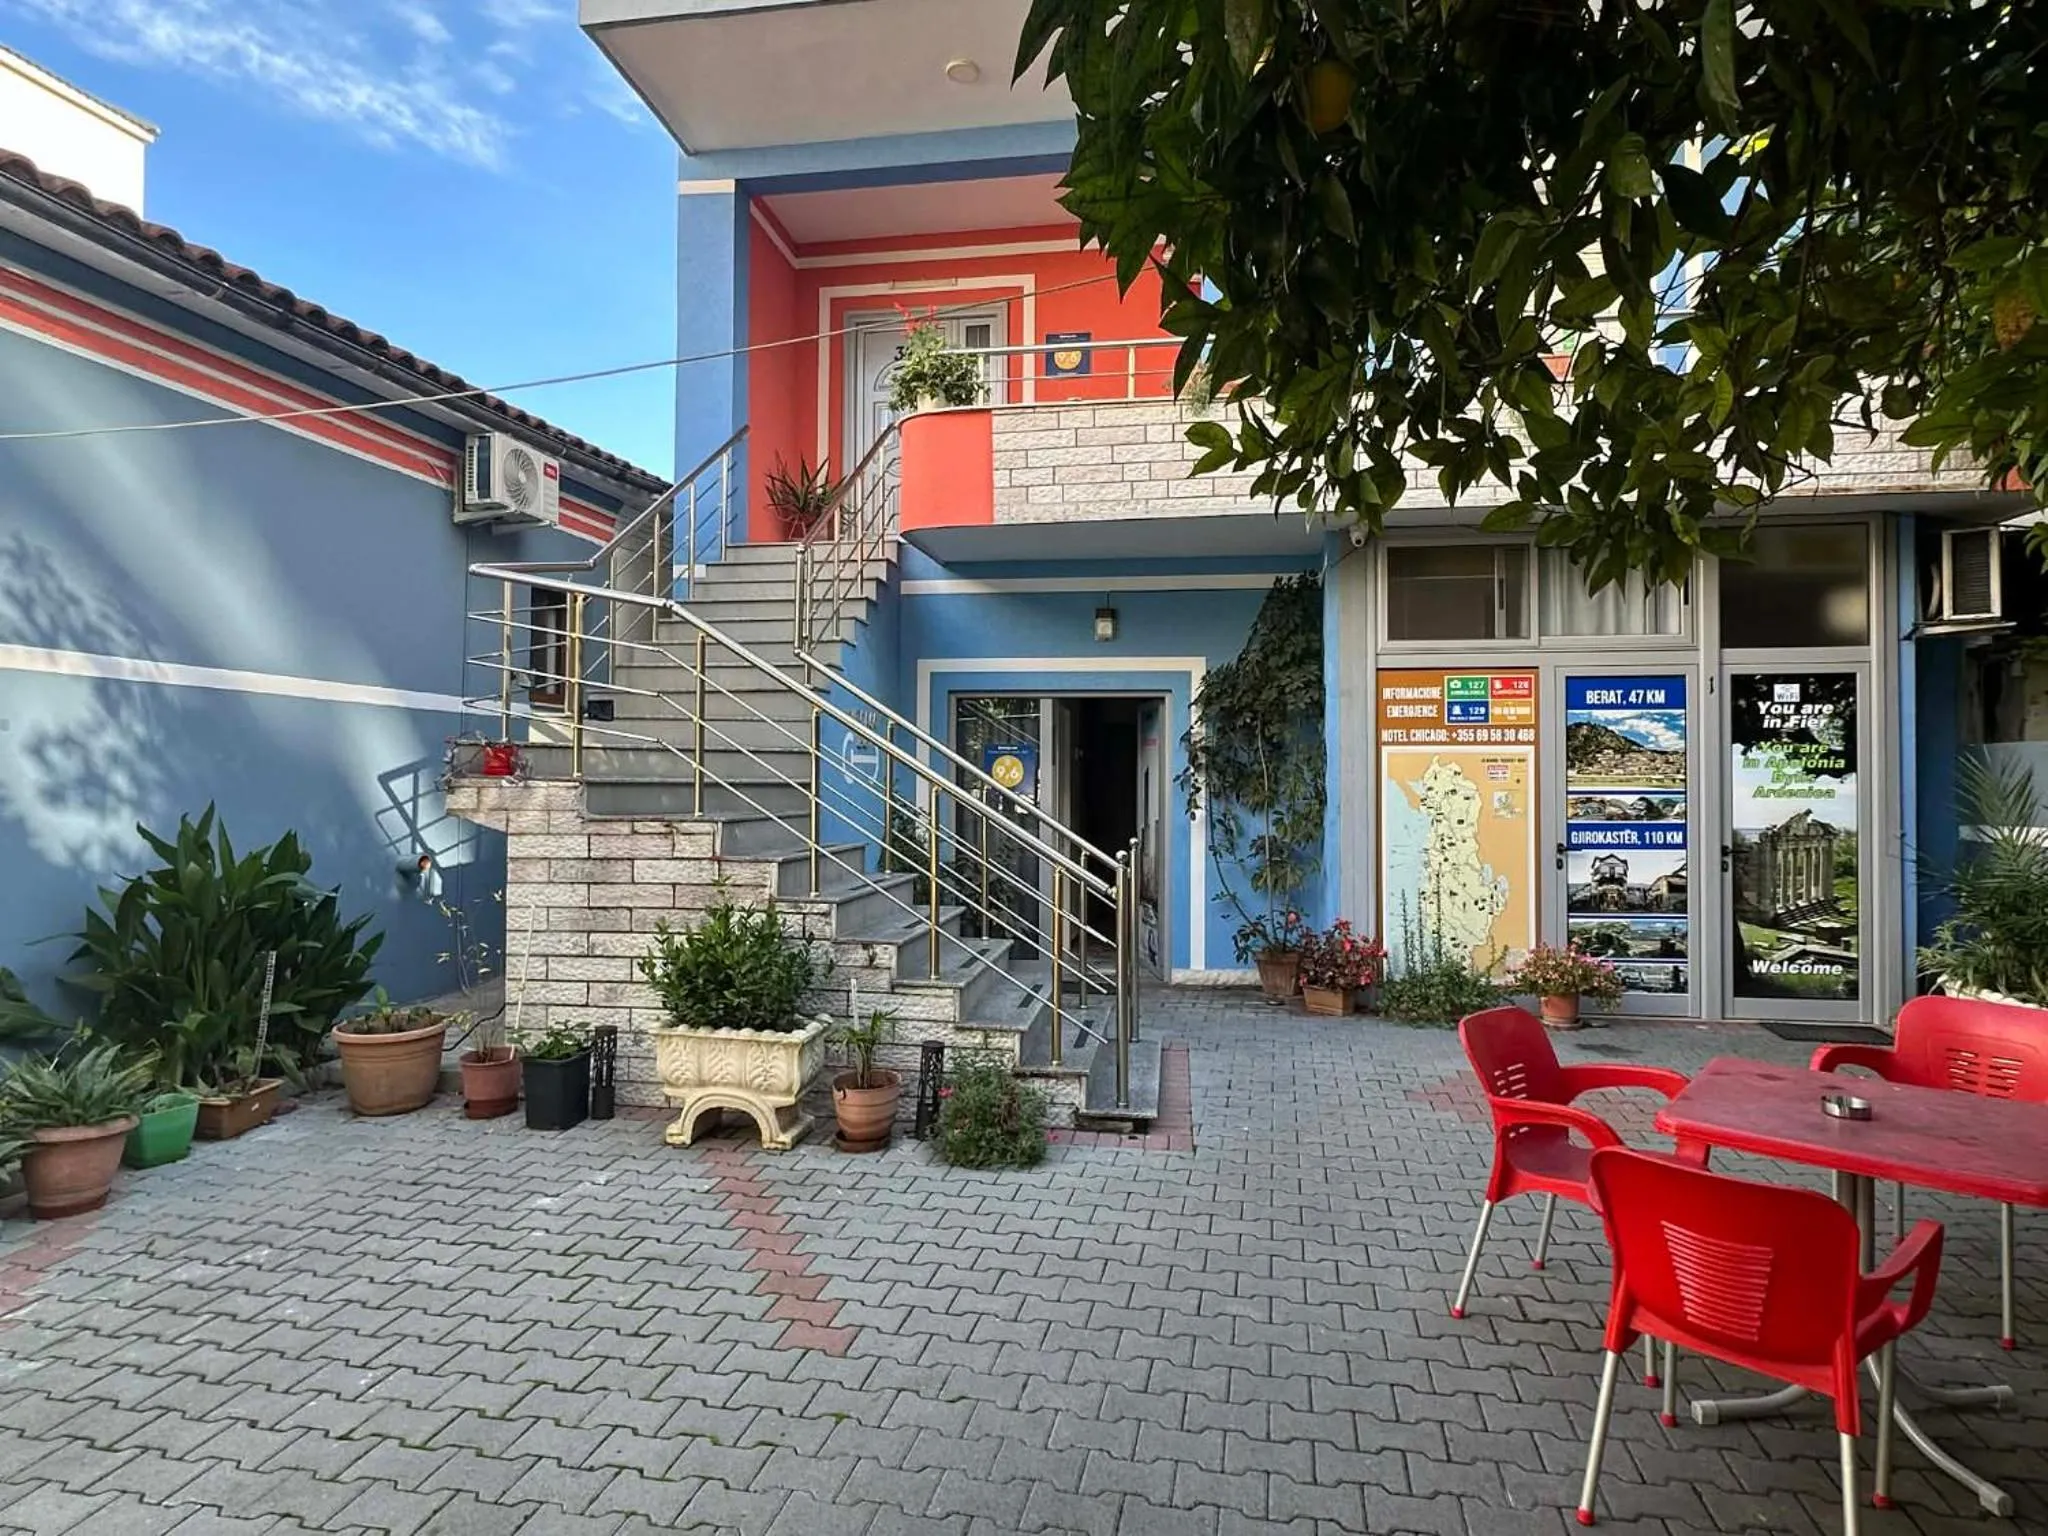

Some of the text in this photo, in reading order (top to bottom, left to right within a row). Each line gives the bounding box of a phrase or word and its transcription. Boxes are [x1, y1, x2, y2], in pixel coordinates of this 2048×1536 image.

[1585, 689, 1666, 705] BERAT, 47 KM
[1469, 706, 1486, 715] 129
[1757, 701, 1835, 715] You are
[1762, 714, 1827, 729] in Fier
[1759, 740, 1829, 754] You are
[1644, 831, 1664, 845] 110
[1666, 831, 1683, 845] KM
[1752, 959, 1843, 975] Welcome
